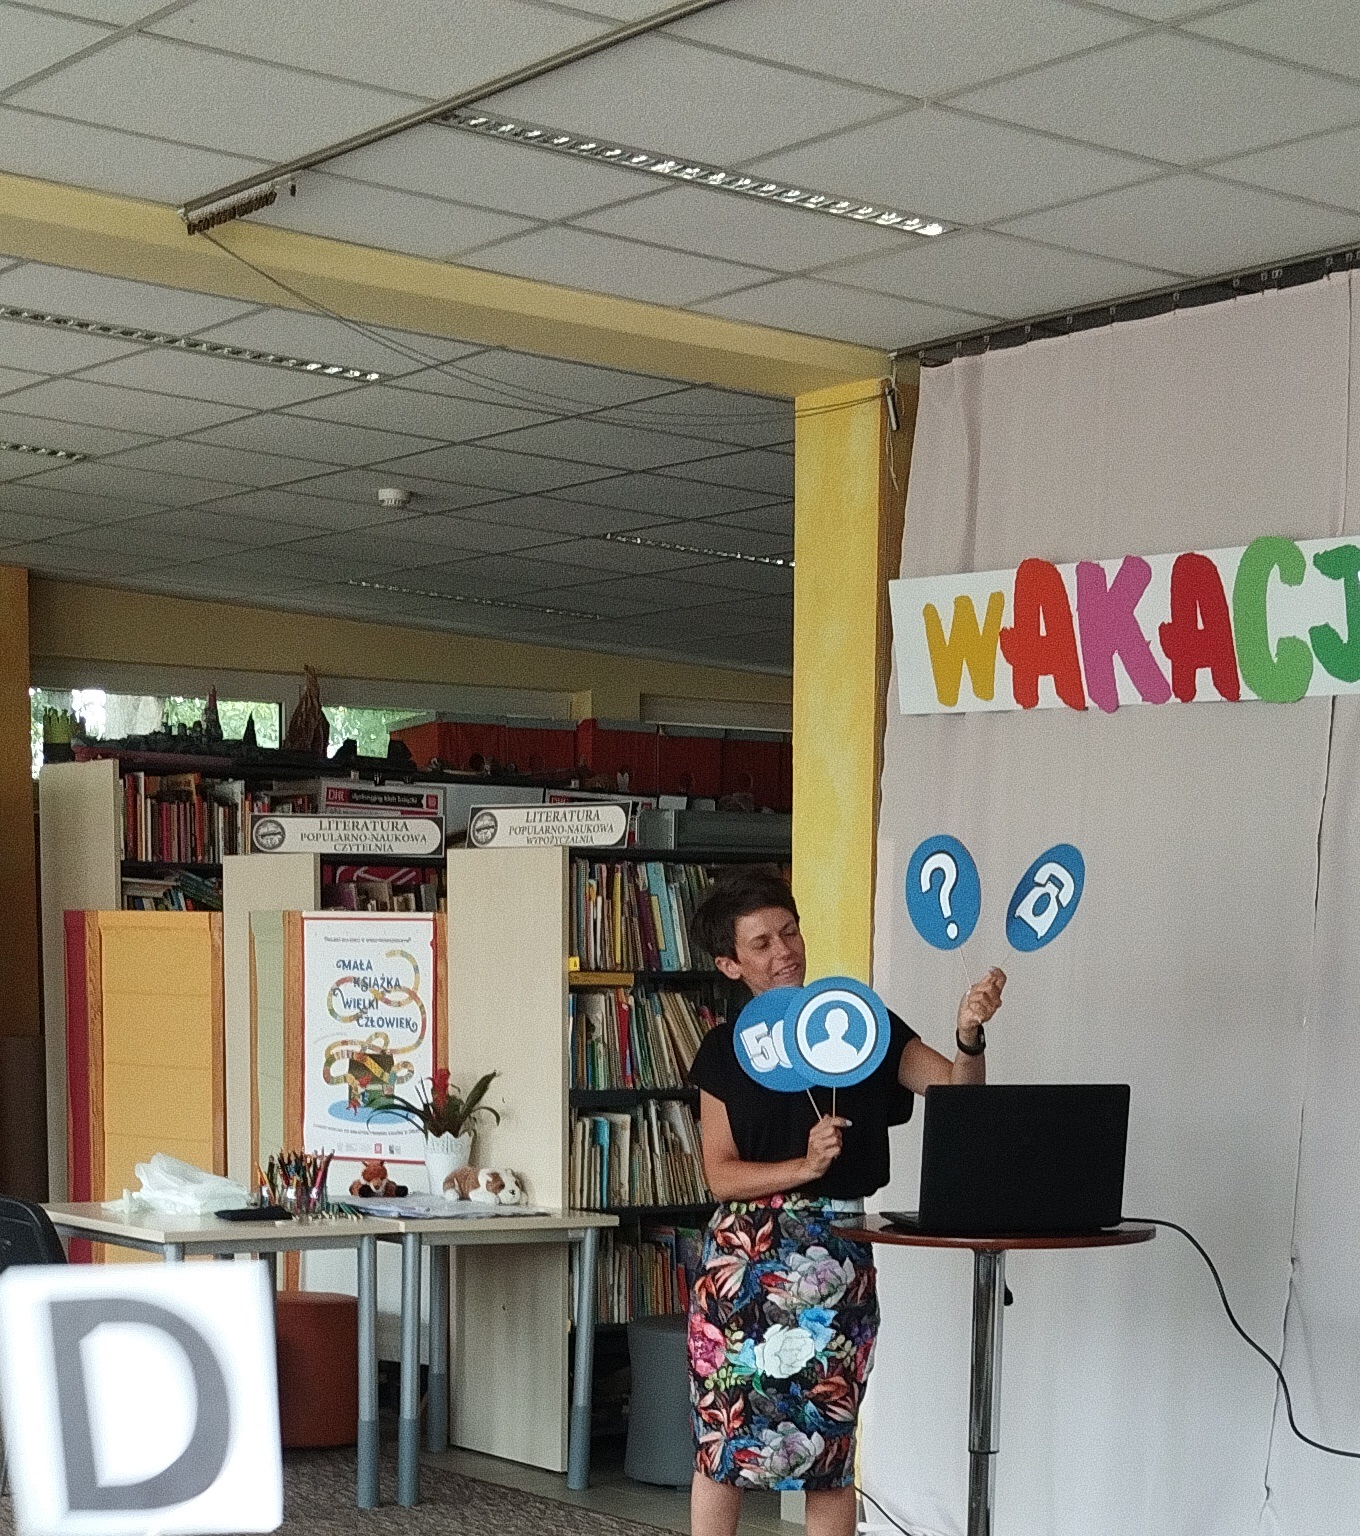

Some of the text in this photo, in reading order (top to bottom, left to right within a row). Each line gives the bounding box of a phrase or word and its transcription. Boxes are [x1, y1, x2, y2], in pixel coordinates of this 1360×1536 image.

[525, 809, 600, 823] LITERATURA
[320, 819, 410, 832] LITERATURA
[508, 823, 614, 835] POPULARNO-NAUKOWA
[300, 832, 427, 844] POPULARNO-NAUKOWA
[526, 834, 594, 845] WYPOŻYCZALNIA
[333, 843, 394, 852] CZYTELNIA
[336, 959, 373, 971] MAŁA
[353, 973, 401, 993] KSIĄŻKA
[332, 988, 379, 1012] WIELKI
[356, 1016, 418, 1033] CZŁOWIEK
[49, 1297, 231, 1512] D
